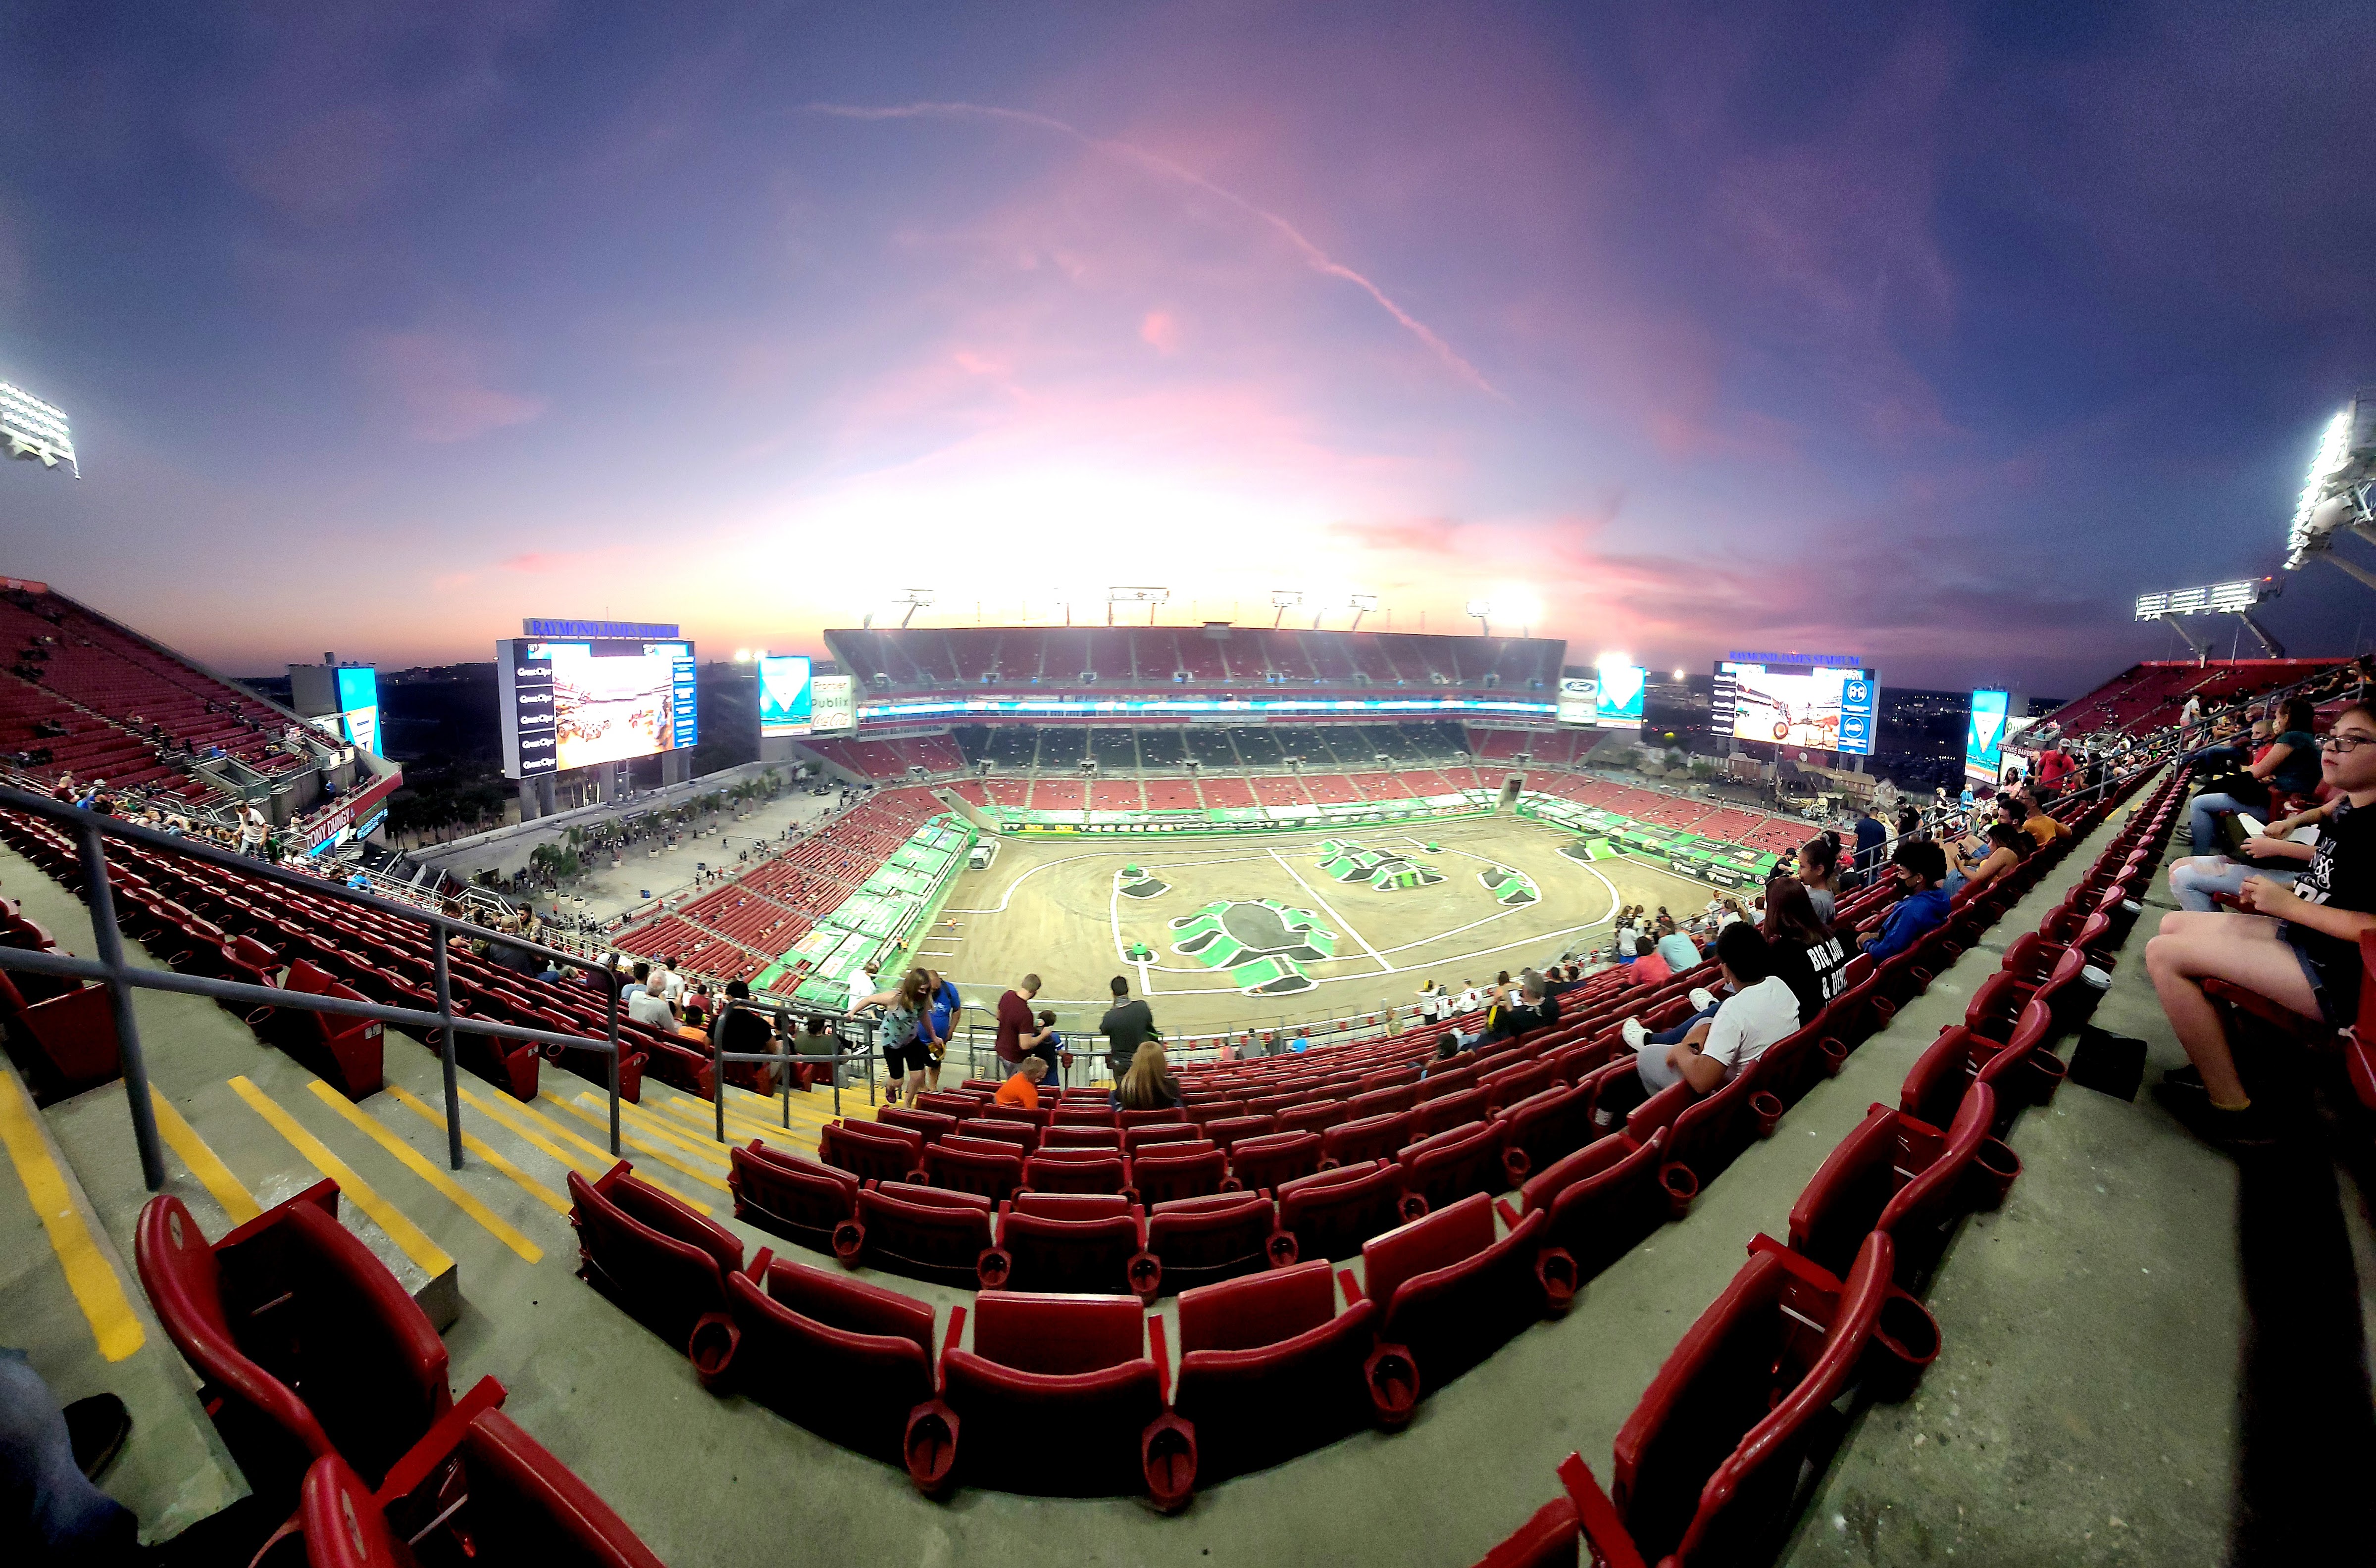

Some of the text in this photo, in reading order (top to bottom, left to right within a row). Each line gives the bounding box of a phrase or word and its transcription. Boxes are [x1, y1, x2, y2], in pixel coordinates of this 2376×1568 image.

[533, 621, 599, 637] RAYMOND
[601, 623, 636, 637] JAMES
[1729, 651, 1860, 666] RAYMOND JAMES STADIUM
[1568, 682, 1591, 692] Ford
[327, 807, 350, 835] DUNGY
[1807, 944, 1833, 972] BIG,
[1822, 977, 1831, 999] &
